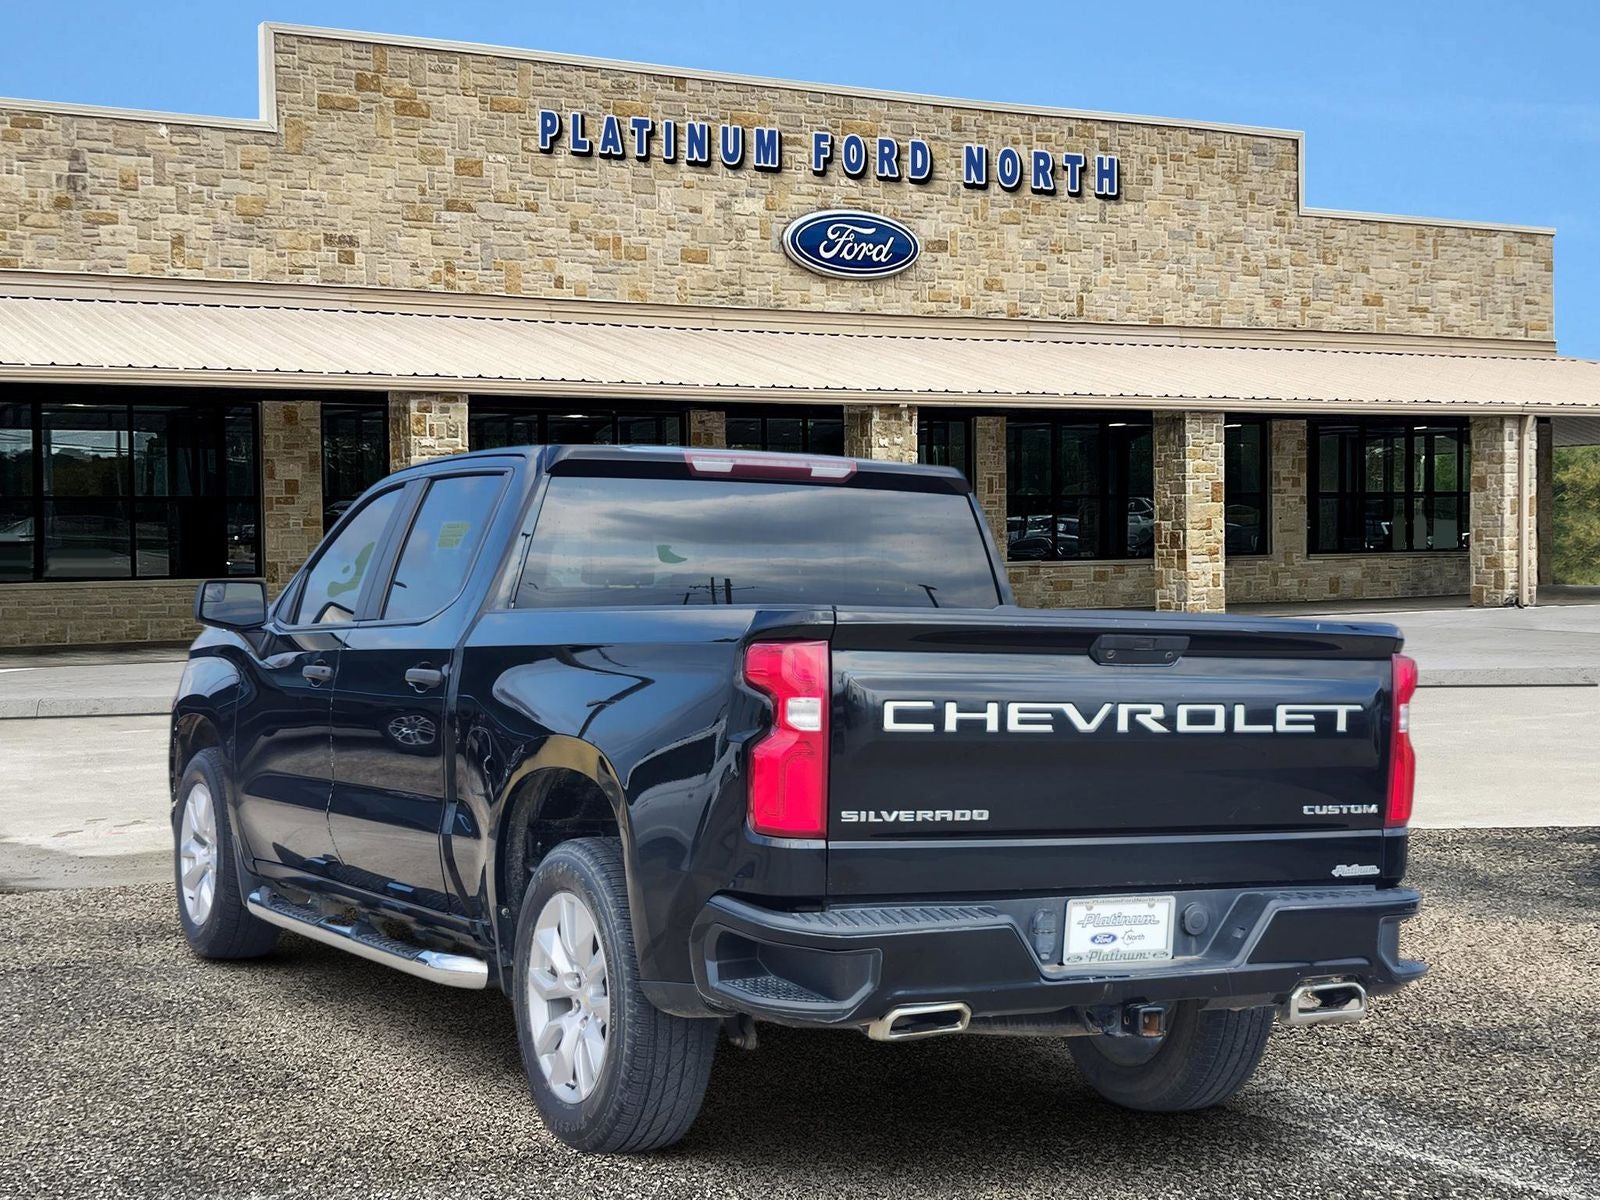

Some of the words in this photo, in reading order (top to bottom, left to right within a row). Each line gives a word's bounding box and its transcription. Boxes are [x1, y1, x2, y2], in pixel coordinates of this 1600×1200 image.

[538, 109, 782, 172] PLATINUM
[812, 132, 933, 184] FORD
[963, 144, 1121, 199] NORTH
[819, 223, 895, 262] Ford
[883, 700, 1364, 733] CHEVROLET
[840, 809, 990, 823] SILVERADO
[1302, 804, 1379, 815] CUSTOM
[1077, 912, 1160, 928] Platinum
[1127, 932, 1146, 942] North
[1088, 950, 1149, 962] Platinum
